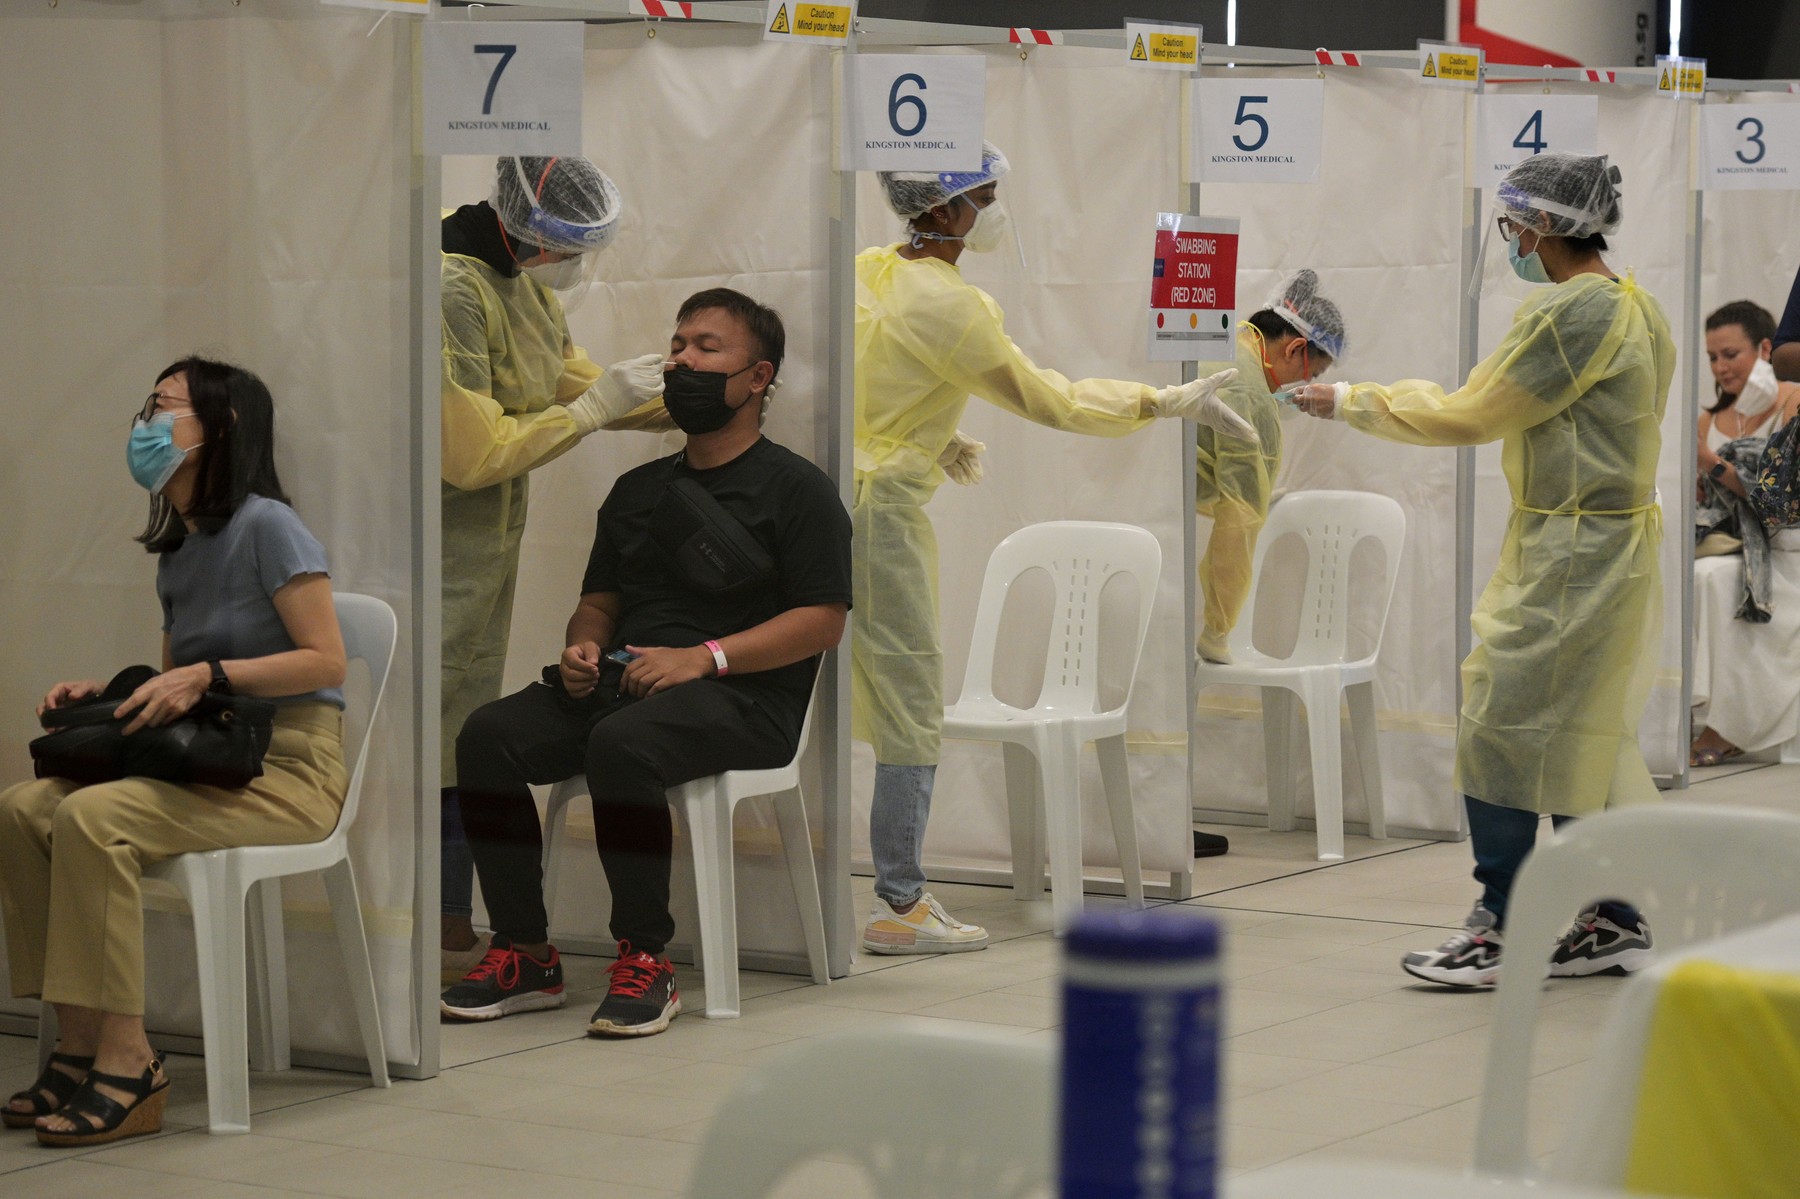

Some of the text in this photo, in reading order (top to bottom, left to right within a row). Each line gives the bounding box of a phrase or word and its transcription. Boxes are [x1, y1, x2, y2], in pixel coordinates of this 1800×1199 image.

[810, 8, 834, 19] Caution
[797, 20, 845, 32] Mind your head
[1162, 37, 1183, 46] Caution
[1153, 48, 1192, 59] Mind your head
[474, 44, 517, 115] 7
[888, 72, 927, 137] 6
[448, 121, 551, 131] KINGSTON MEDICAL
[1232, 96, 1269, 152] 5
[1512, 110, 1548, 155] 4
[1736, 117, 1766, 164] 3
[865, 141, 956, 149] KINGSTON MEDICAL
[1255, 155, 1295, 163] MEDICAL
[1175, 237, 1216, 255] SWABBING
[1178, 263, 1211, 279] STATION
[1171, 286, 1216, 308] (RED ZONE)
